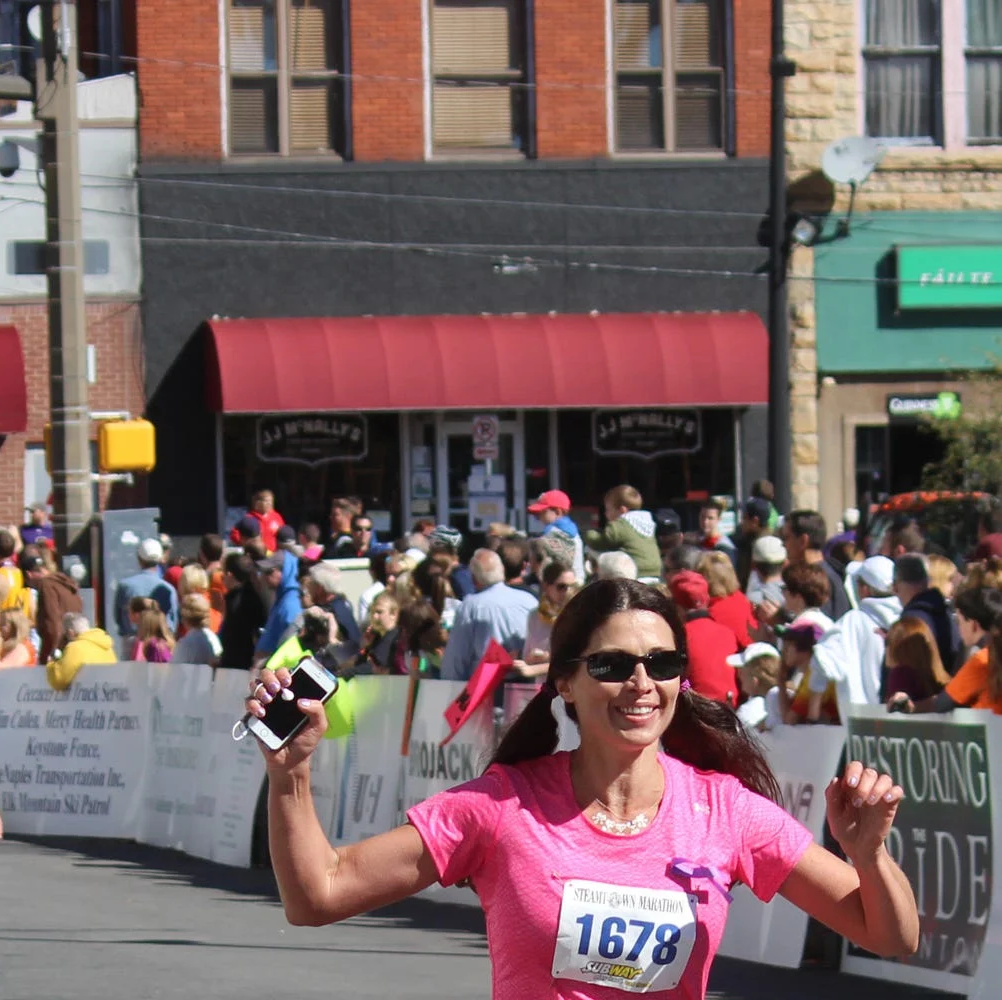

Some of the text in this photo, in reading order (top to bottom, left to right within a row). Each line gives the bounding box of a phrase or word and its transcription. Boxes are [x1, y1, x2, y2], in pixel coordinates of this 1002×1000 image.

[73, 709, 106, 730] Health
[25, 736, 68, 761] Keystone
[35, 764, 106, 790] Transportation
[19, 791, 61, 813] Mountain
[81, 794, 112, 815] Patrol
[639, 895, 684, 913] MARATHON
[576, 913, 681, 965] 1678
[581, 961, 643, 980] SUBWAY
